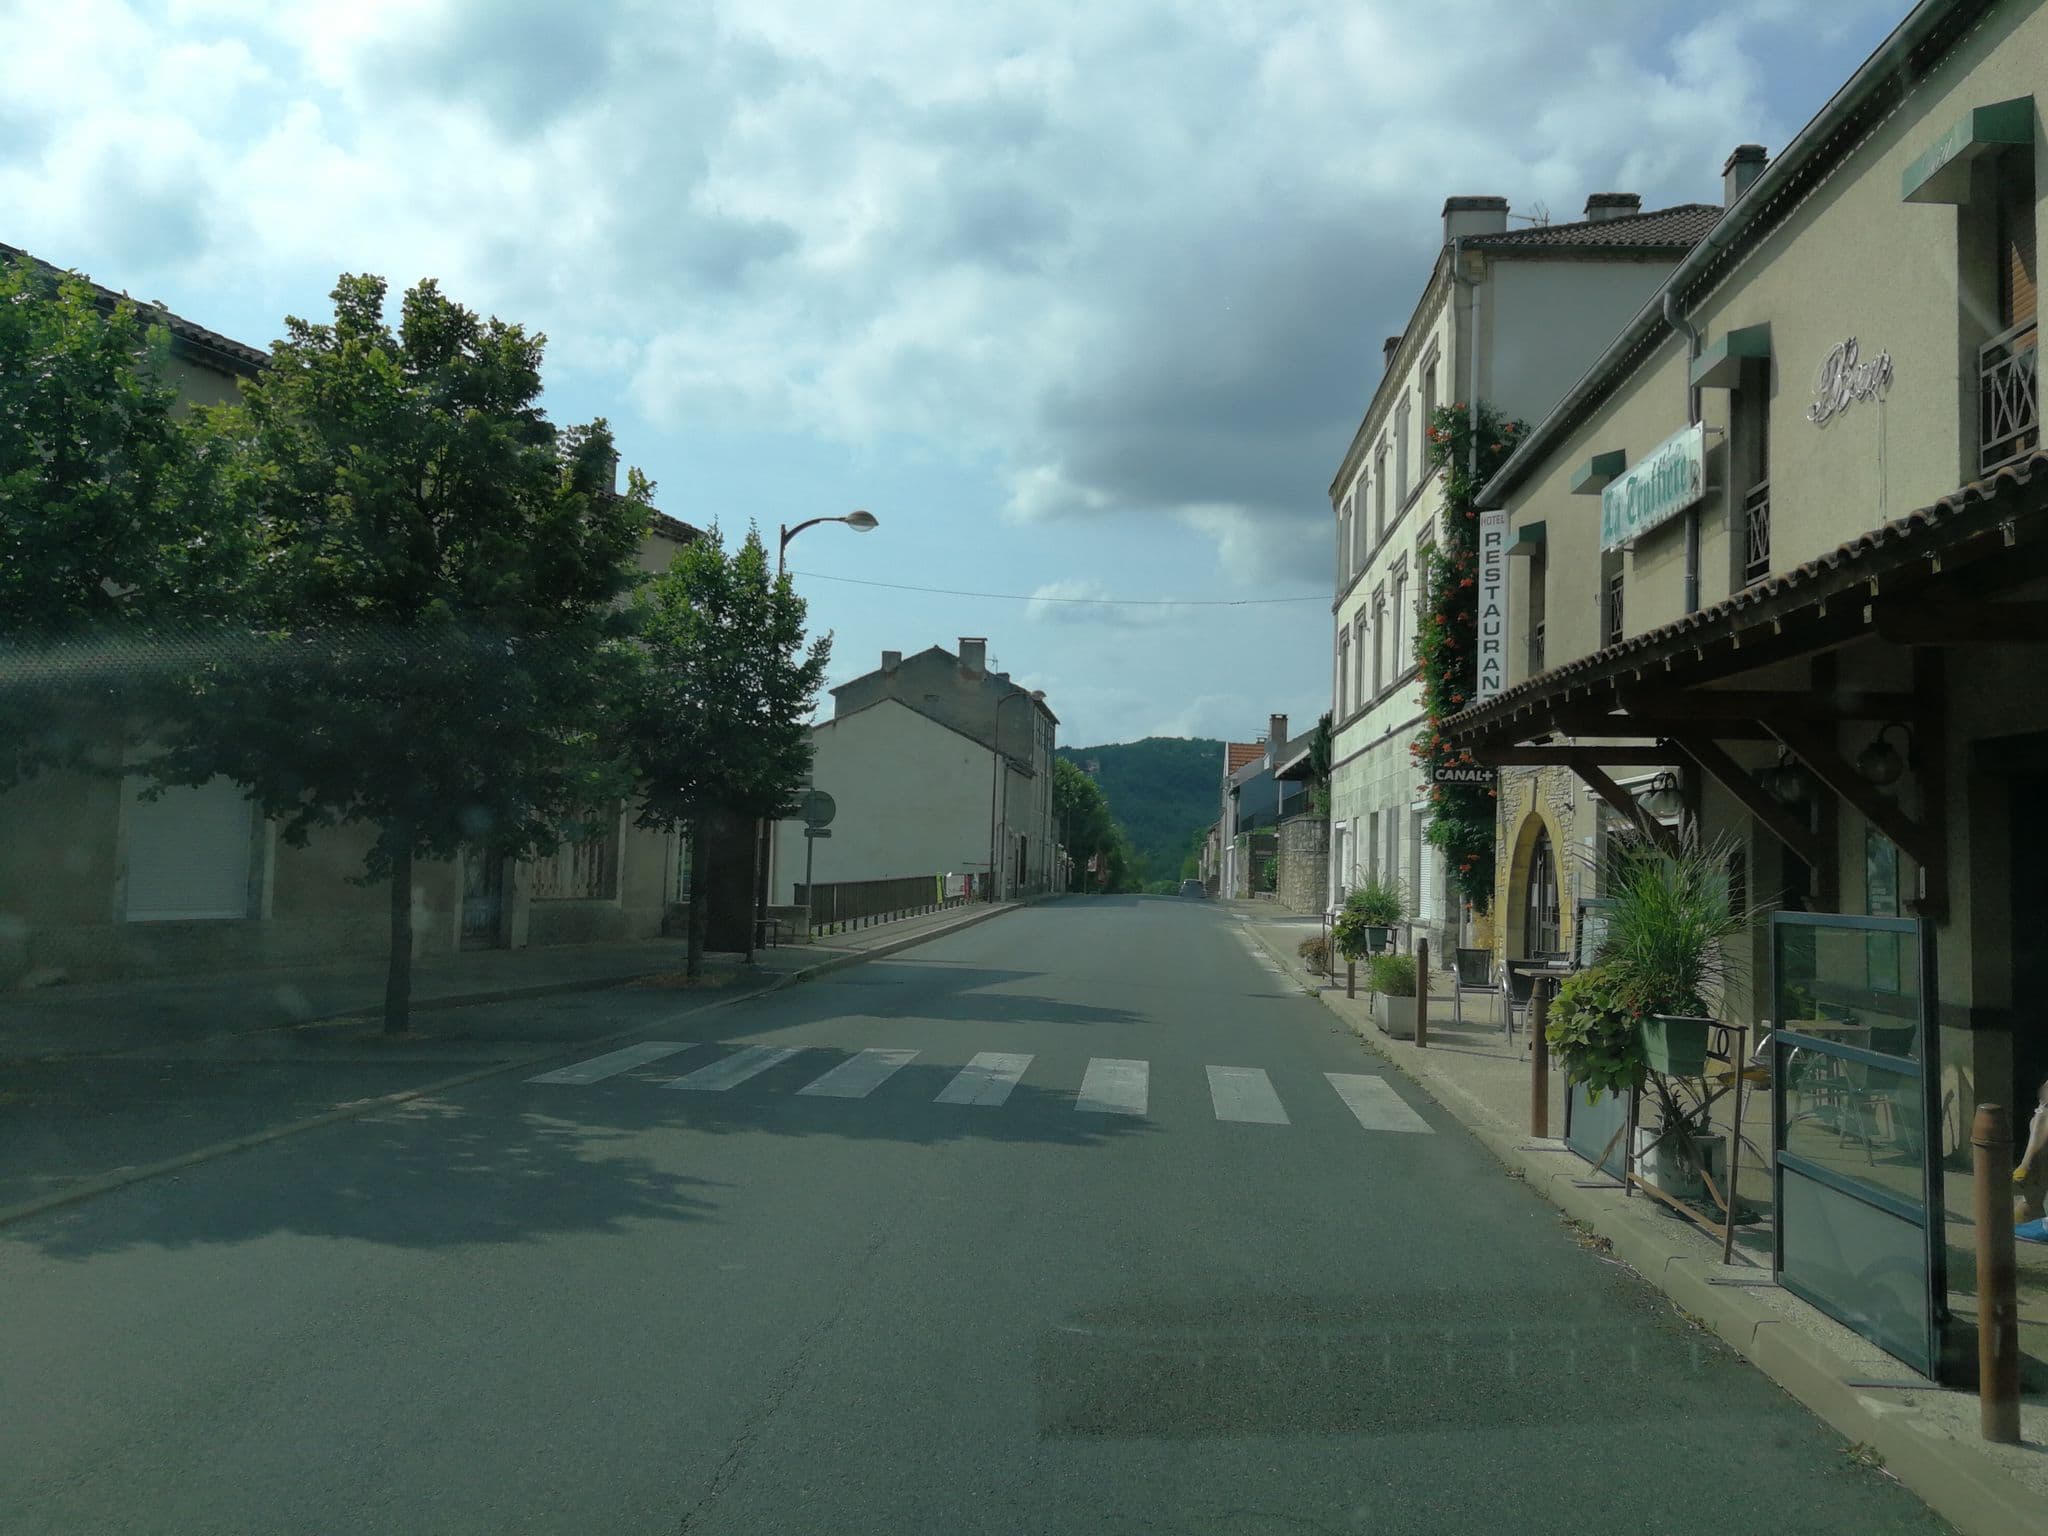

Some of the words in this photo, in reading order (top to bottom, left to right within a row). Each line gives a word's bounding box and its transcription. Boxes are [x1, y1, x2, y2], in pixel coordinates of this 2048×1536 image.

[1603, 489, 1621, 538] La
[1481, 514, 1505, 527] HOTEL
[1435, 768, 1493, 781] CANAL+
